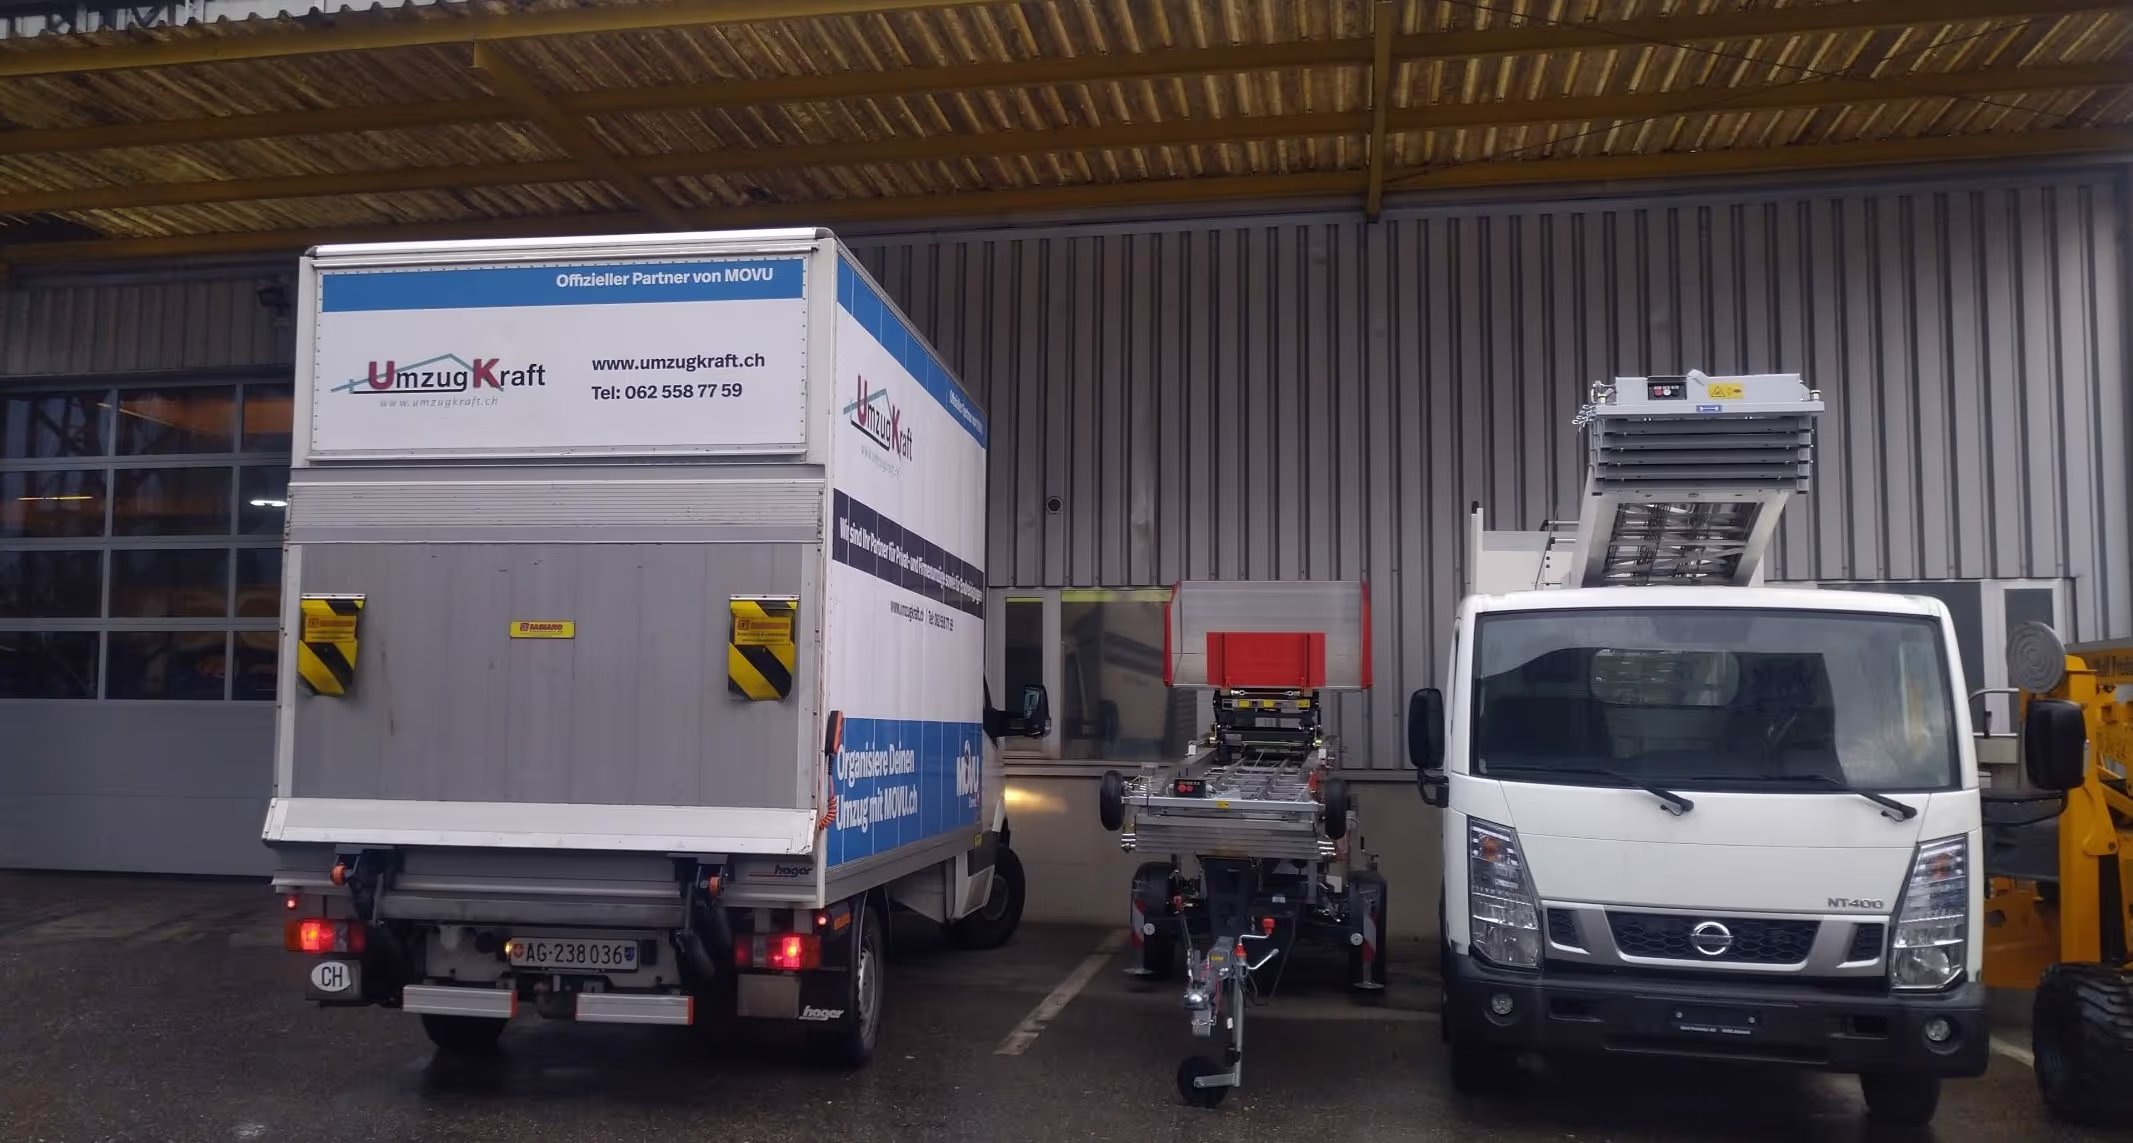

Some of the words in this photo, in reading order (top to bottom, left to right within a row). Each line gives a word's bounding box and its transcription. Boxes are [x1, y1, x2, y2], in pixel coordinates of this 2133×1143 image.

[556, 273, 629, 287] Offizieller
[632, 270, 688, 285] Partner
[692, 270, 721, 283] von
[724, 267, 774, 282] MOVU
[592, 353, 765, 372] www.umzugkraft.ch
[591, 385, 621, 400] Tel:
[624, 385, 658, 399] 062
[662, 384, 694, 398] 558
[697, 383, 718, 398] 77
[721, 383, 742, 397] 59
[380, 396, 498, 408] www.umzugkraft.ch
[850, 522, 862, 547] sind
[837, 741, 888, 788] Organisiere
[889, 742, 914, 774] Deinen
[836, 794, 868, 833] Umzug
[869, 787, 884, 823] mit
[884, 784, 918, 821] MOVU.ch
[1828, 898, 1884, 909] NT400
[321, 966, 343, 987] CH
